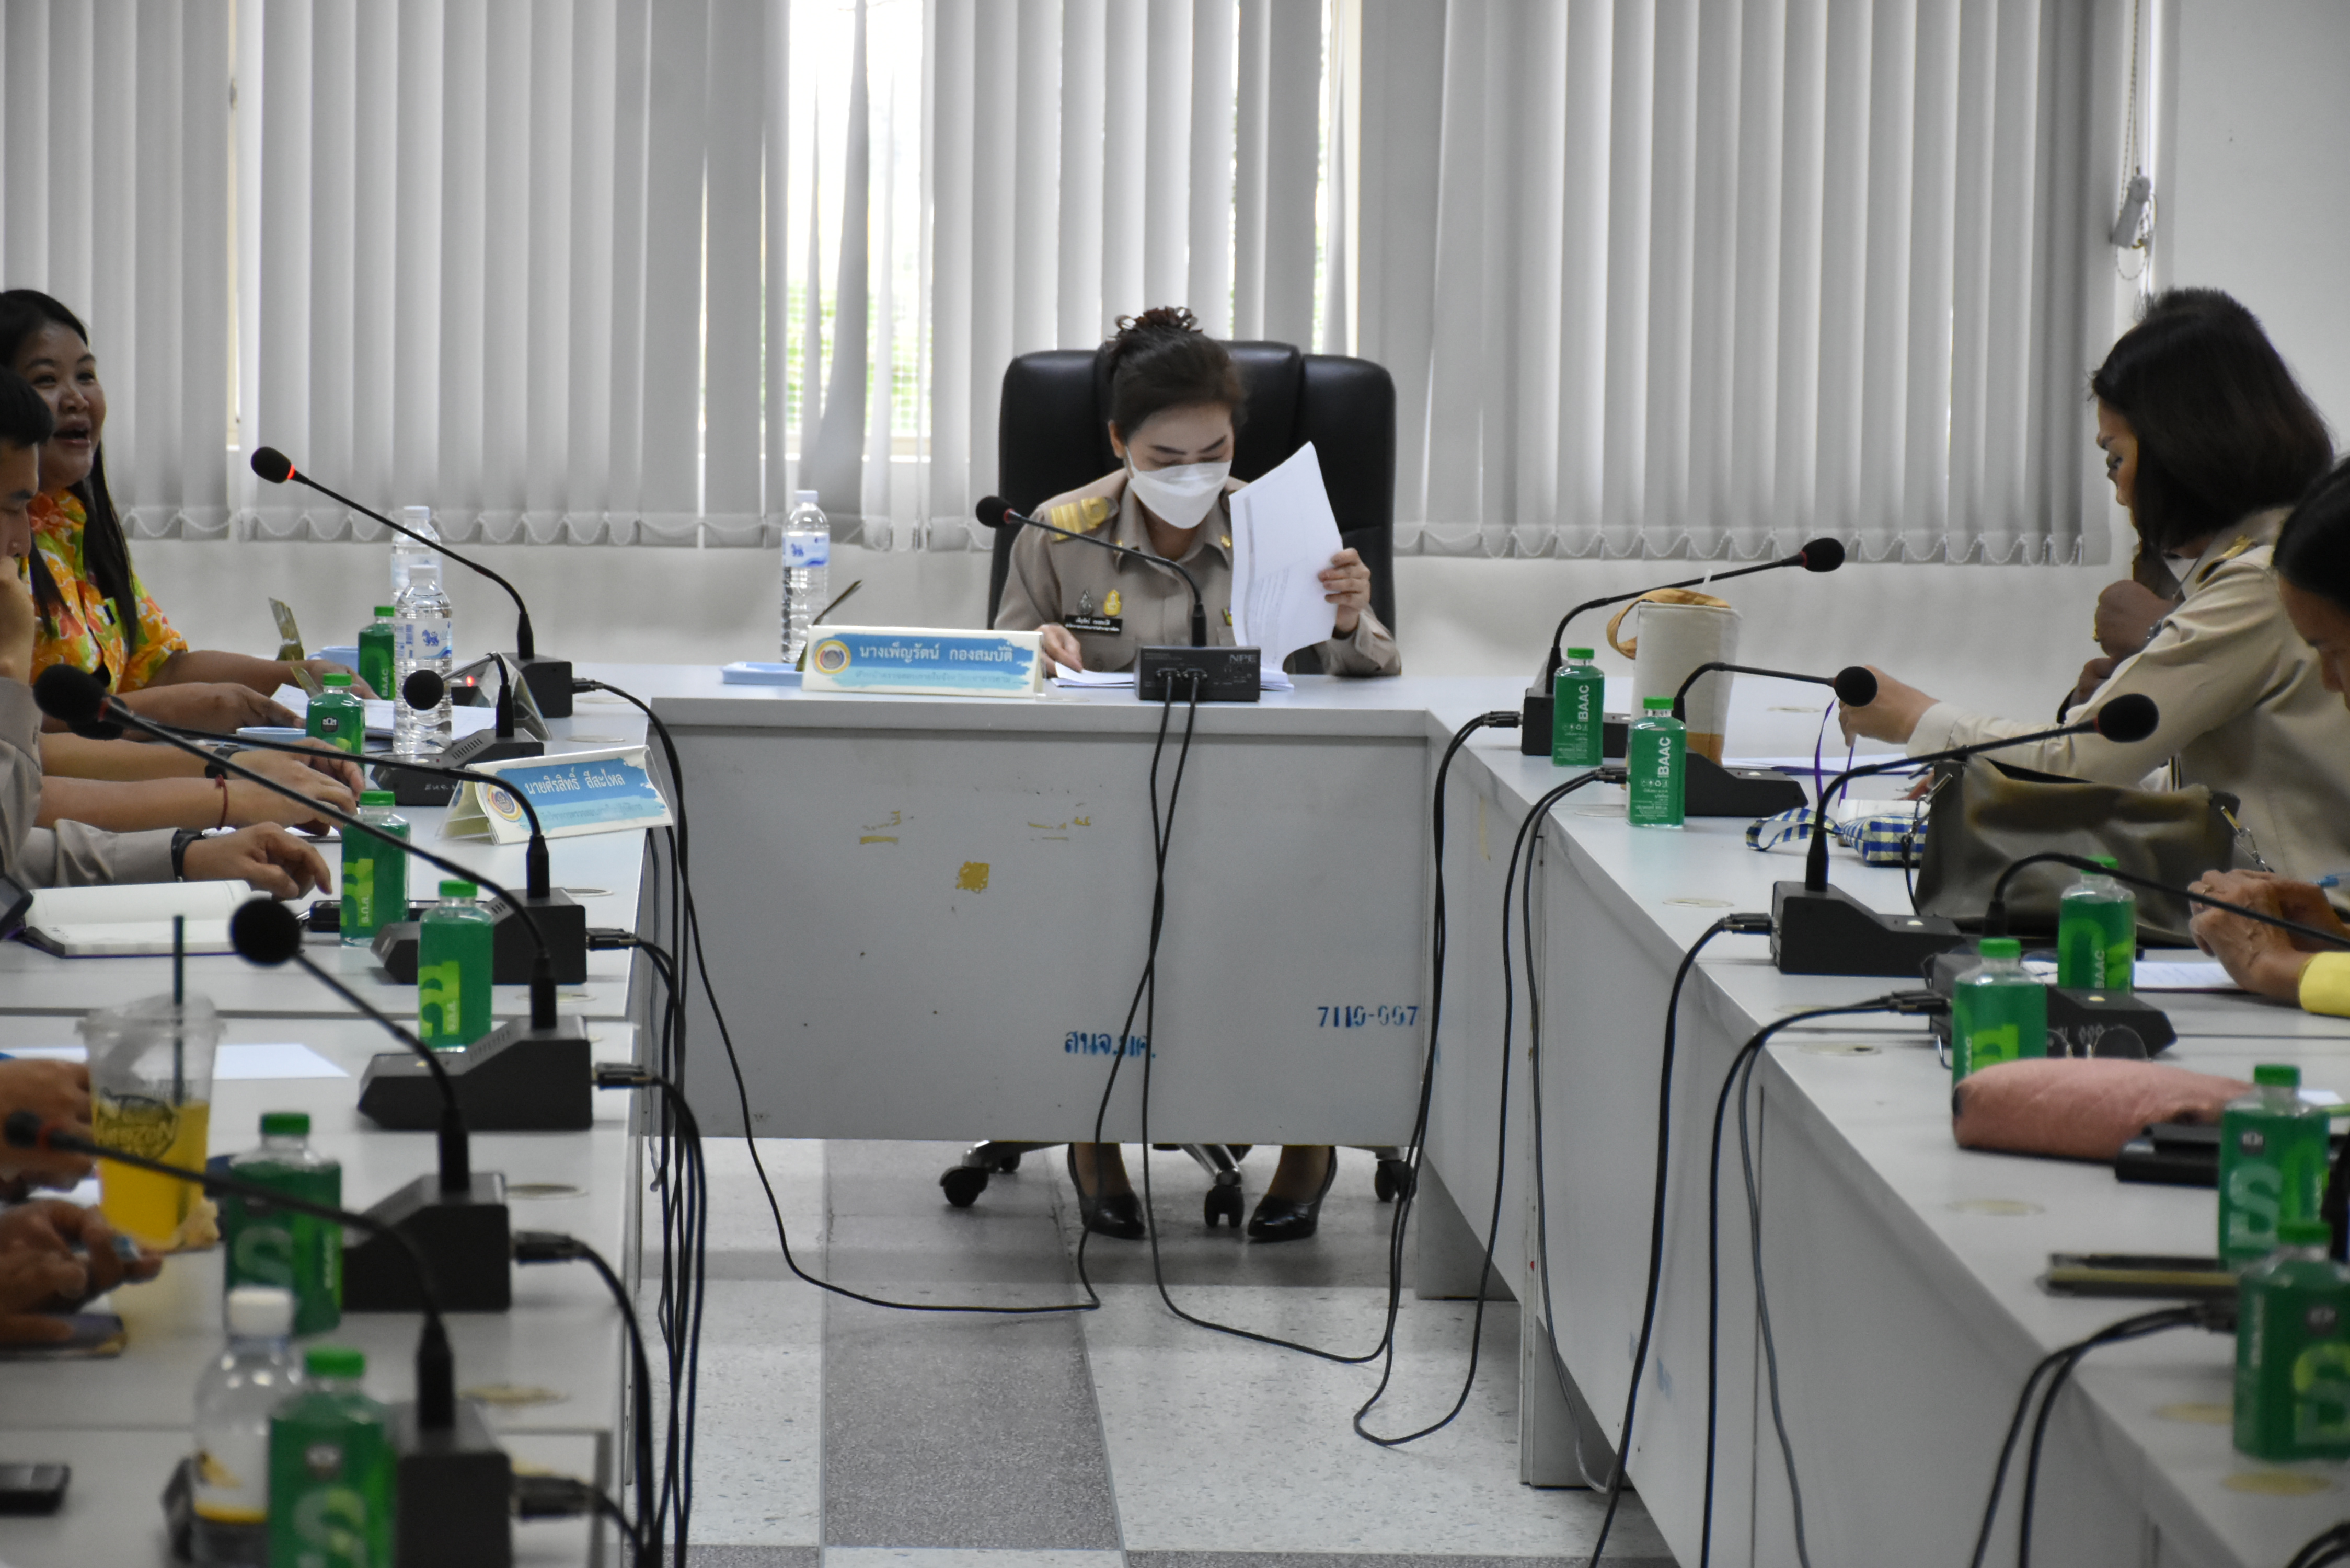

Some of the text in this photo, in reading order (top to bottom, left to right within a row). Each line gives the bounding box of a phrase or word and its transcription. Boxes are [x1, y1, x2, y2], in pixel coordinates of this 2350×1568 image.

[860, 642, 1013, 663] นางเพ็ญรัตน์ กองสมบัติ
[1578, 685, 1589, 720] BAAC
[1658, 737, 1671, 775] BAAC
[2094, 950, 2105, 989] BAAC
